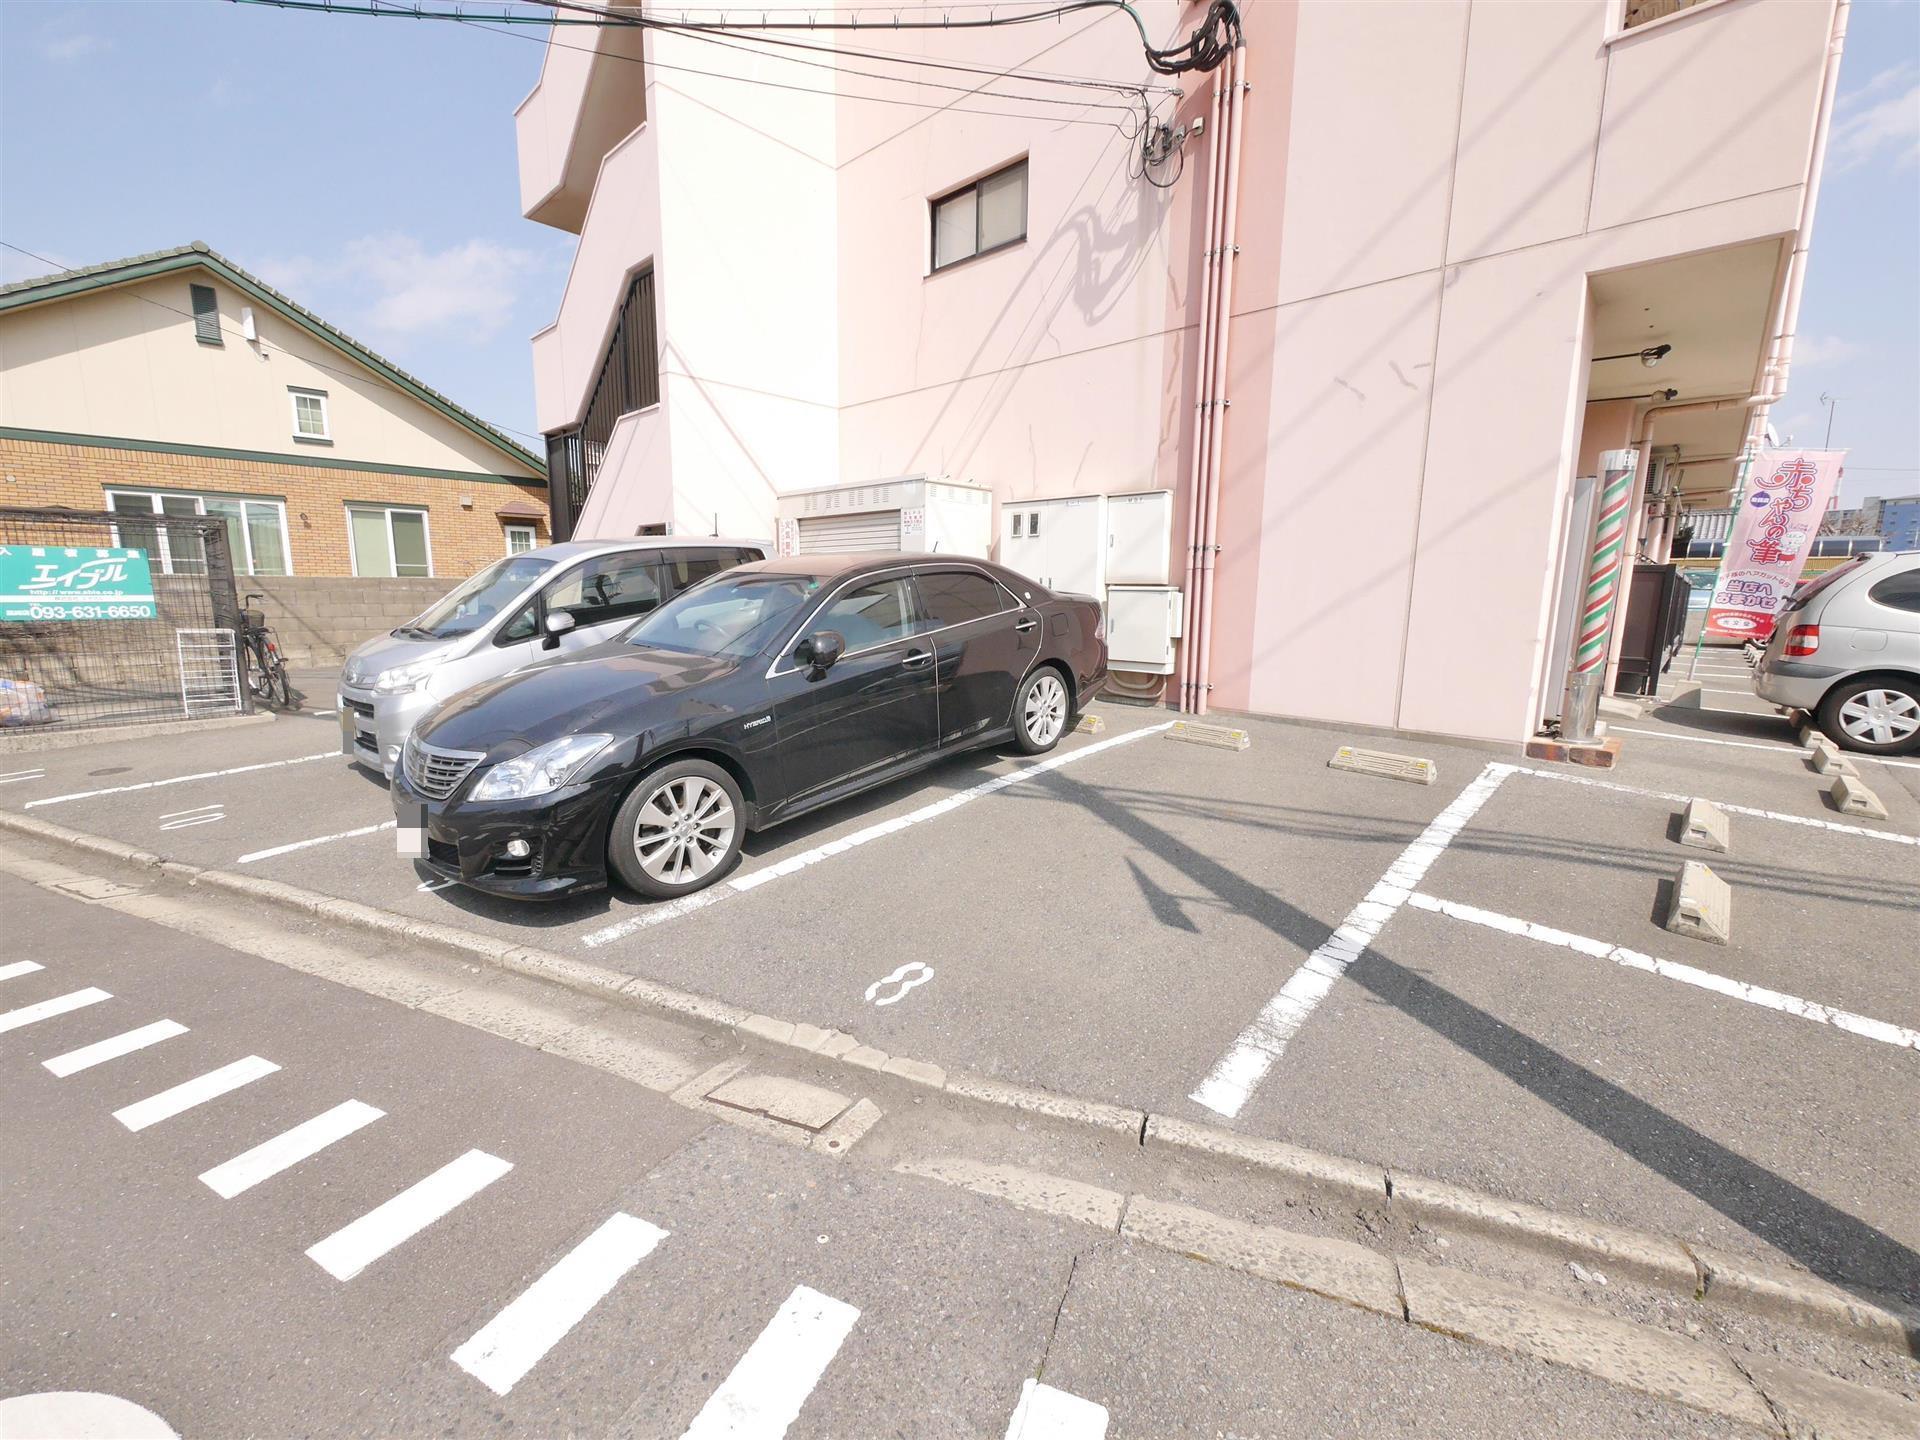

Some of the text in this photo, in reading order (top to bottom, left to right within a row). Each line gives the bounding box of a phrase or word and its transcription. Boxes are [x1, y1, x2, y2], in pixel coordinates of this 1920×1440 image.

[1746, 458, 1817, 565] 赤ちゃんの筆
[18, 557, 129, 590] エイブル
[1715, 592, 1777, 609] おまかせ
[1726, 580, 1773, 596] 当店へ
[30, 605, 151, 619] 093-631-6650
[864, 961, 935, 1006] 8
